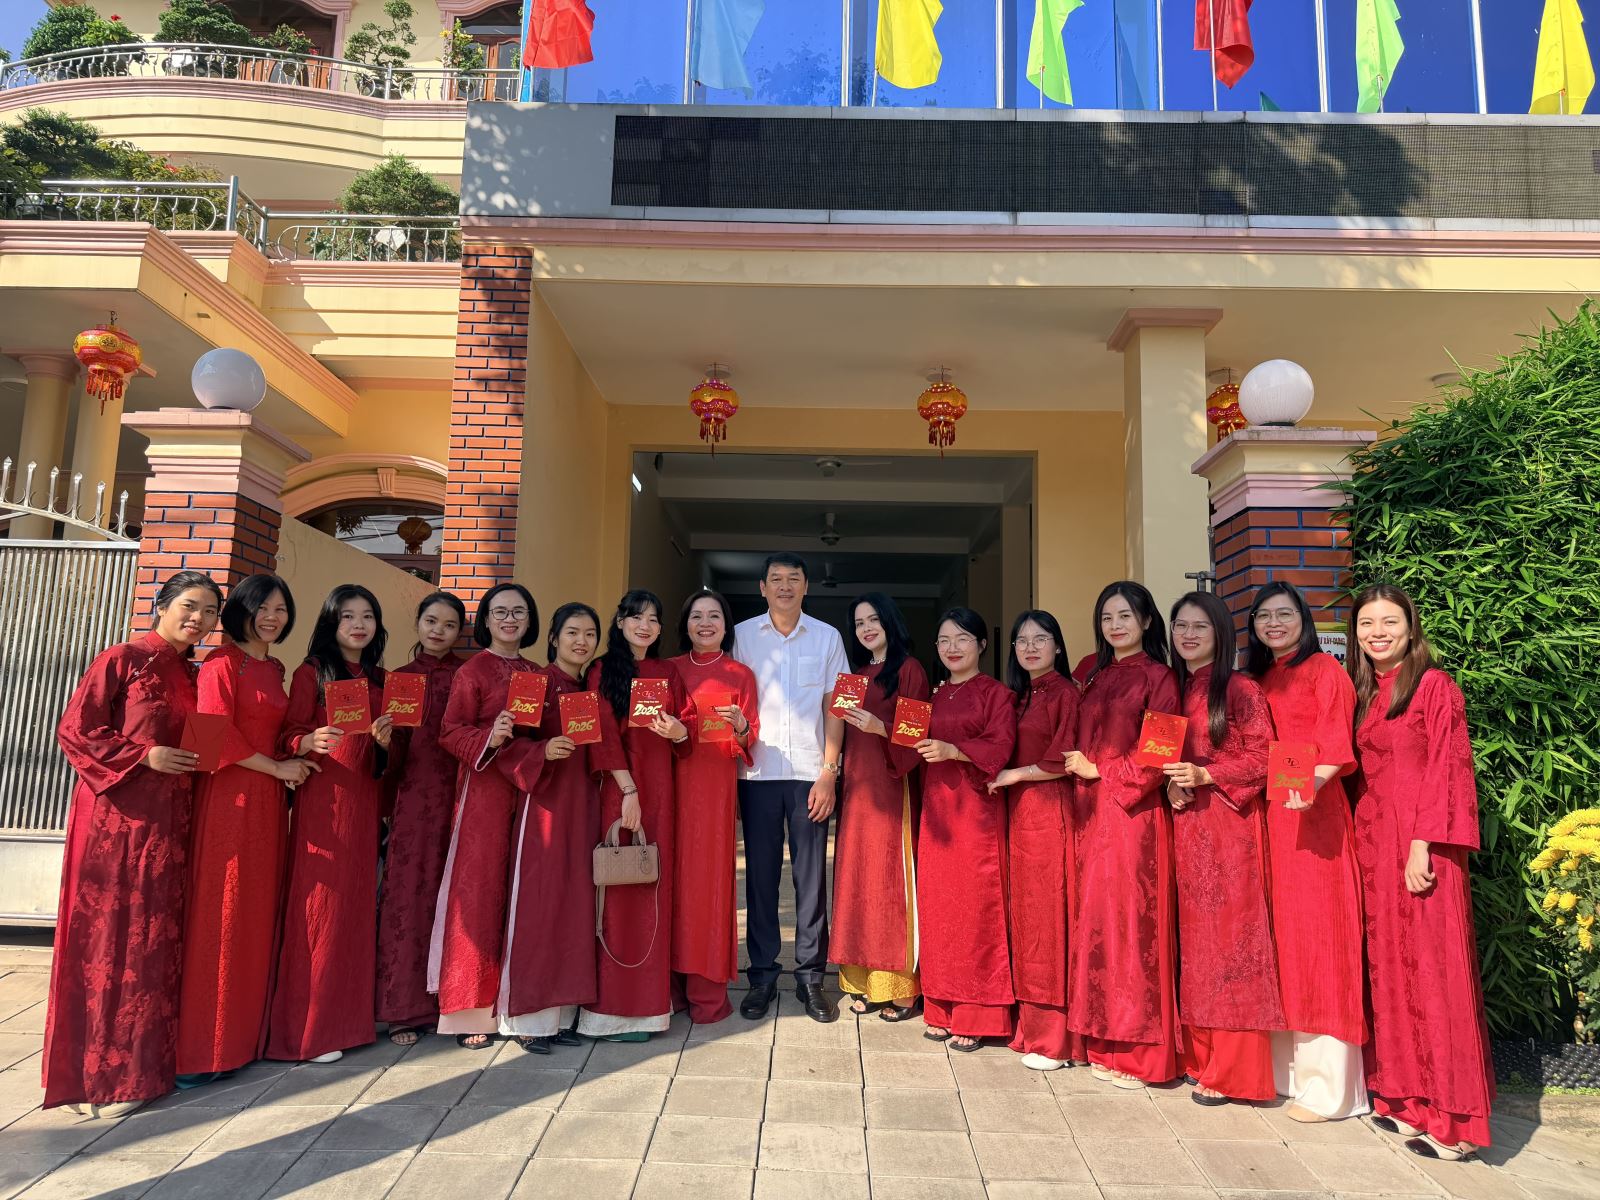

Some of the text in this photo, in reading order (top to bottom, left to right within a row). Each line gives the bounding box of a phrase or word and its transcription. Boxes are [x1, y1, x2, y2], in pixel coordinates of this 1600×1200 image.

[385, 700, 419, 714] 2026
[508, 699, 540, 714] 2026
[632, 703, 663, 717] 2026
[832, 696, 861, 709] 2026
[332, 707, 366, 725] 2026
[566, 718, 596, 735] 2026
[895, 722, 925, 738] 2026
[1141, 739, 1178, 757] 2026
[1271, 773, 1311, 789] 2026
